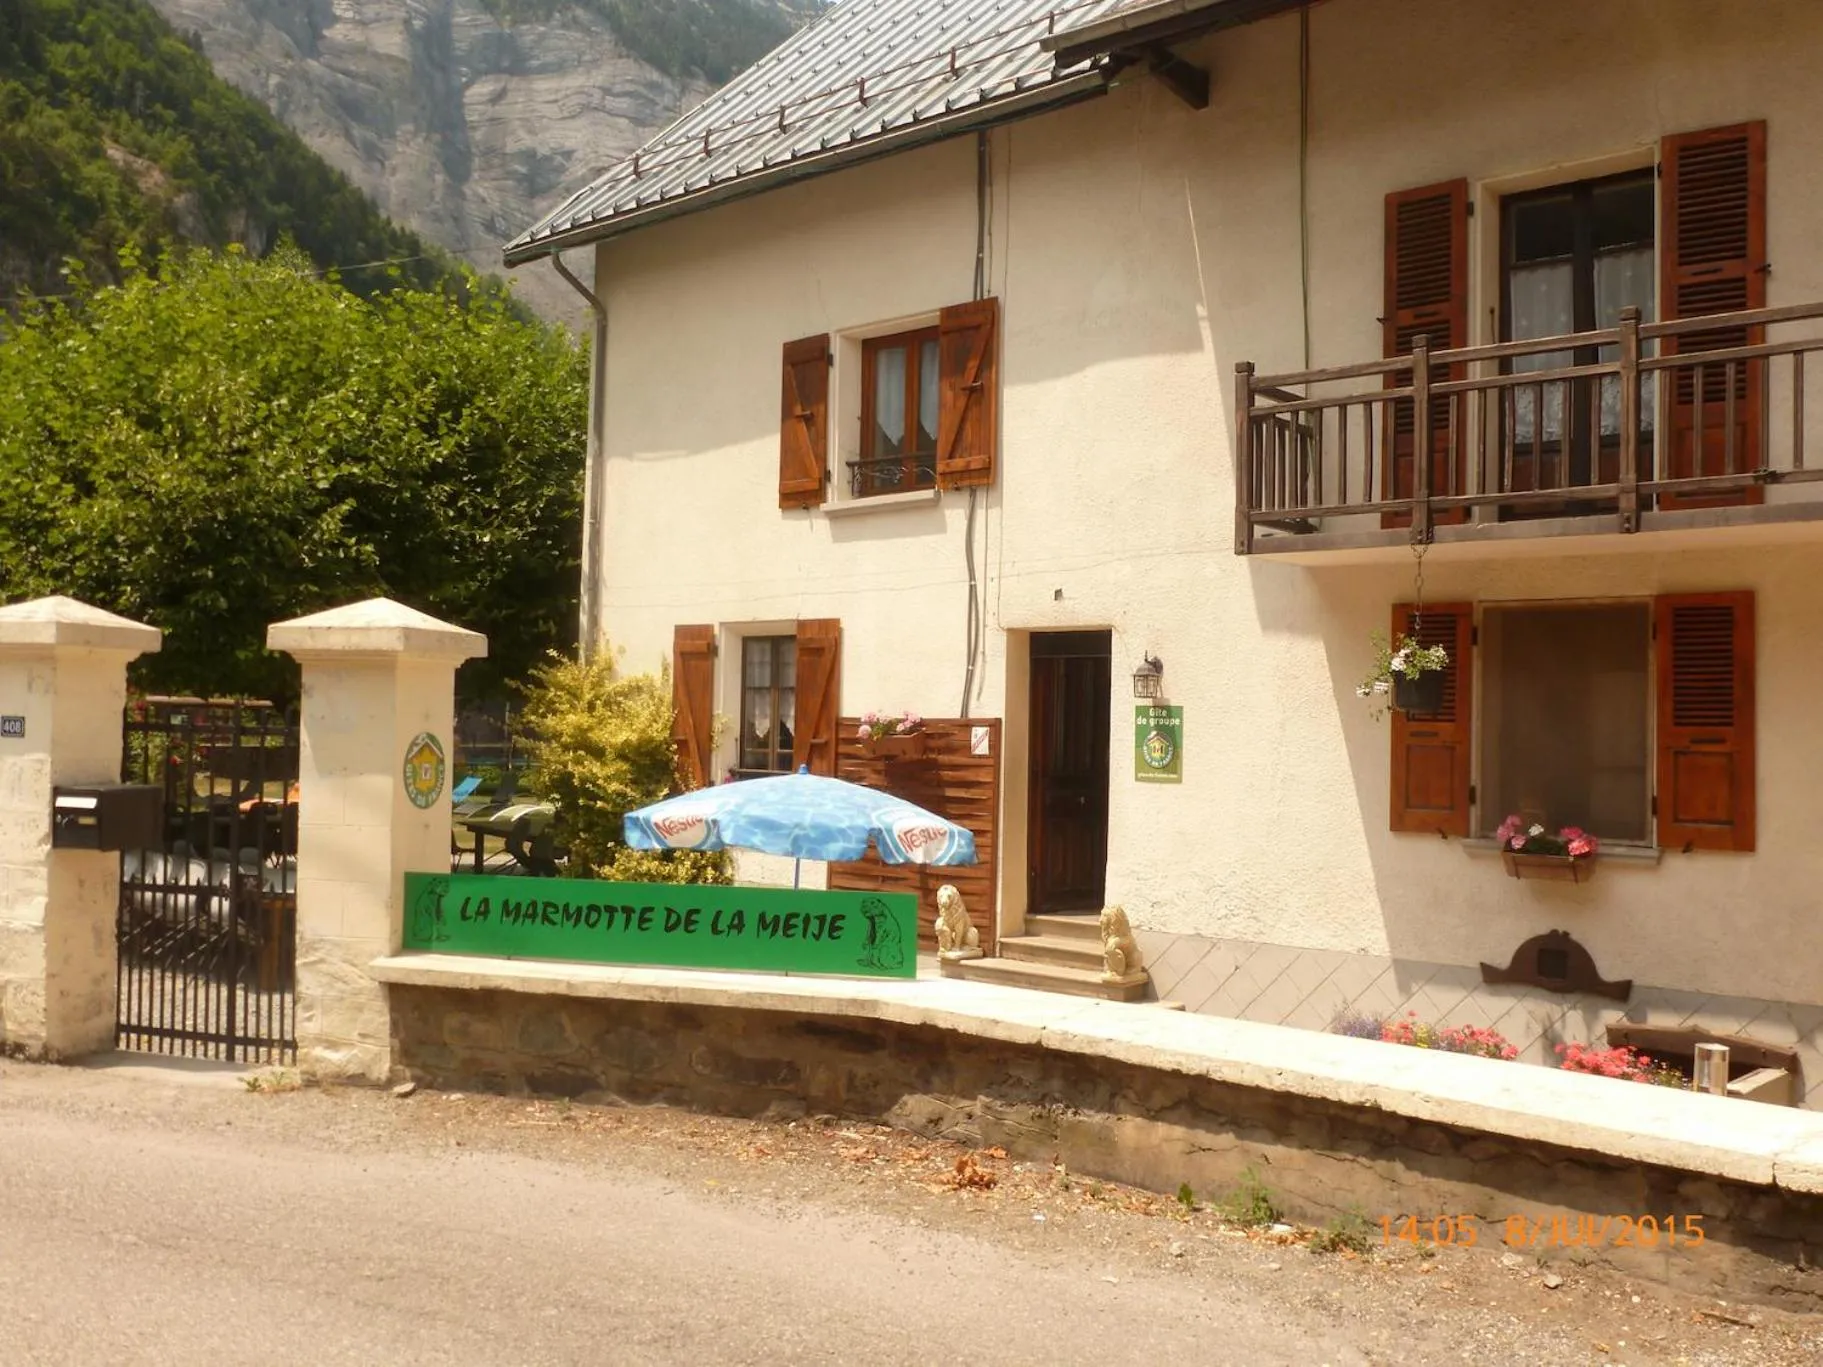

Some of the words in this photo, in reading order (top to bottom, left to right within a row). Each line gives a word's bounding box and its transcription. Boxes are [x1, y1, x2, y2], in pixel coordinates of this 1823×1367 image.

[3, 720, 22, 733] 408
[1136, 716, 1147, 725] de
[1149, 718, 1180, 727] groupe
[459, 896, 490, 924] LA
[499, 898, 657, 931] MARMOTTE
[663, 906, 698, 933] DE
[710, 908, 745, 937] LA
[756, 911, 847, 941] MEIJE
